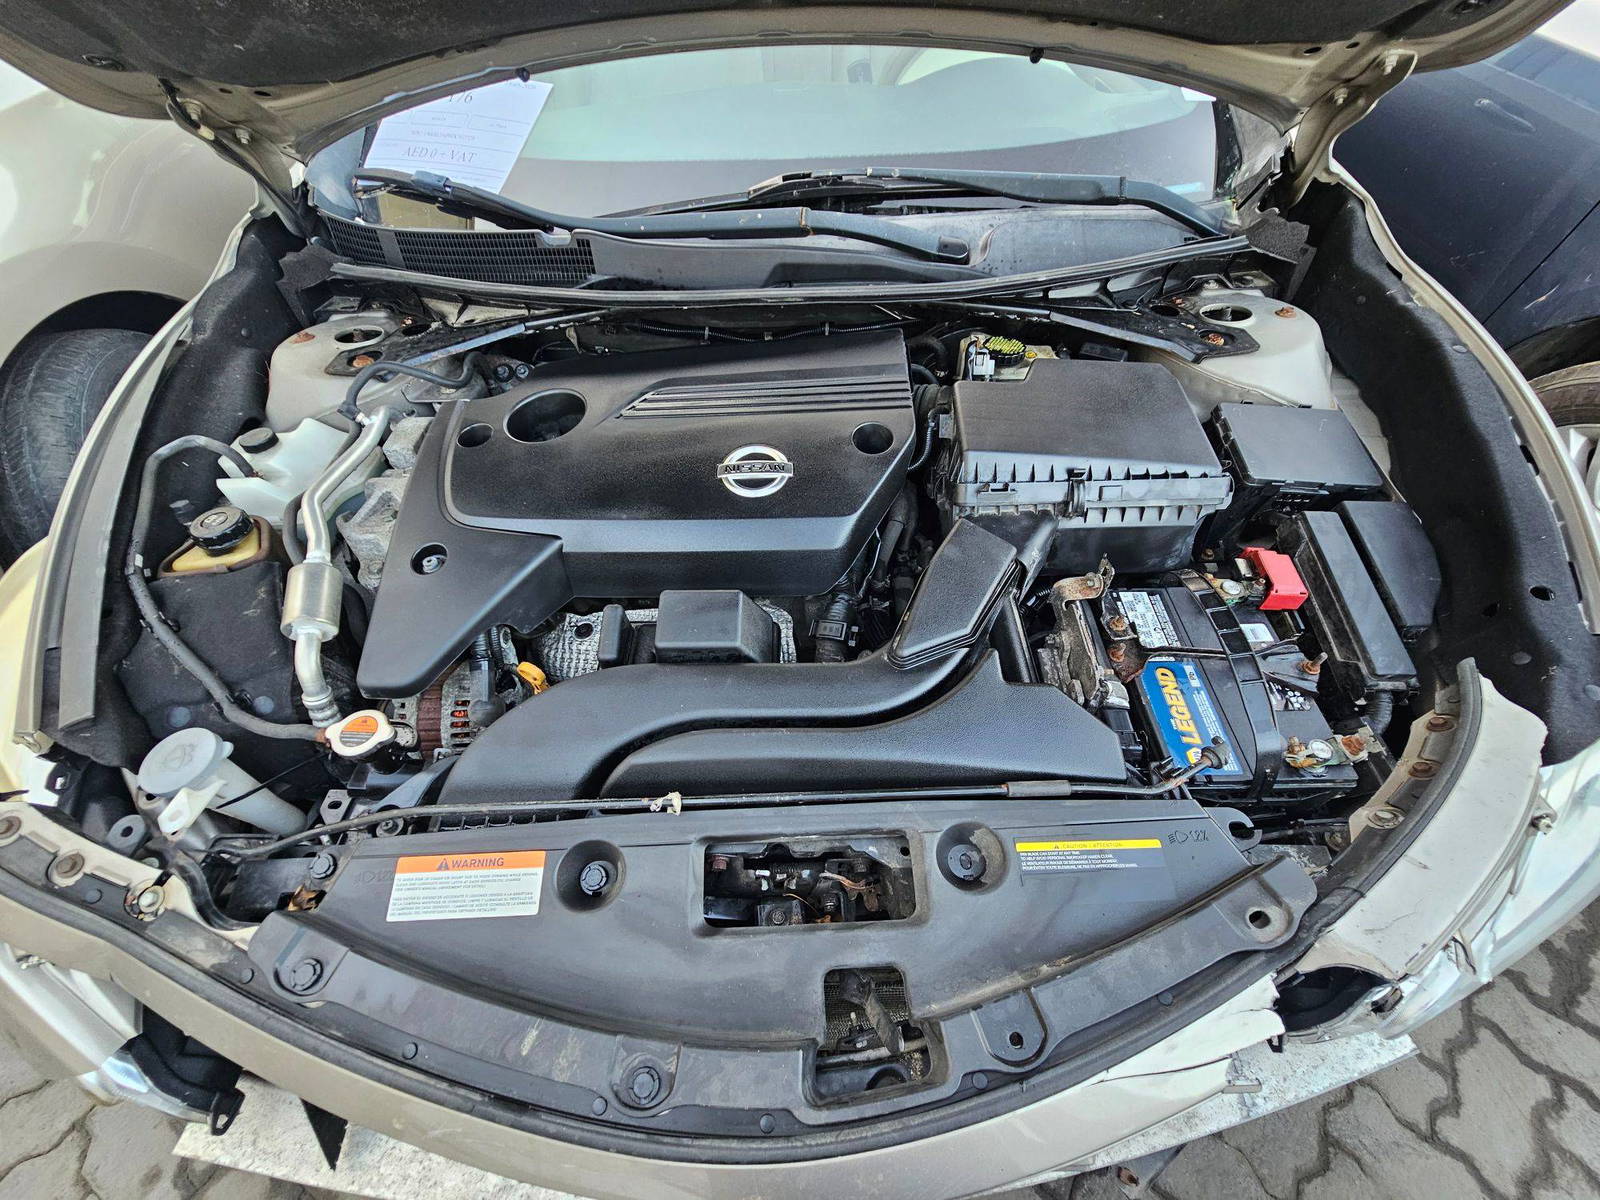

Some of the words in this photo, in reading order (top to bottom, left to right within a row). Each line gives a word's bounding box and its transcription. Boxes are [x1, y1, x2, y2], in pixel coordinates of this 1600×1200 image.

[724, 463, 785, 474] NISSAN
[1155, 666, 1204, 745] LEGEND
[452, 857, 504, 868] WARNING
